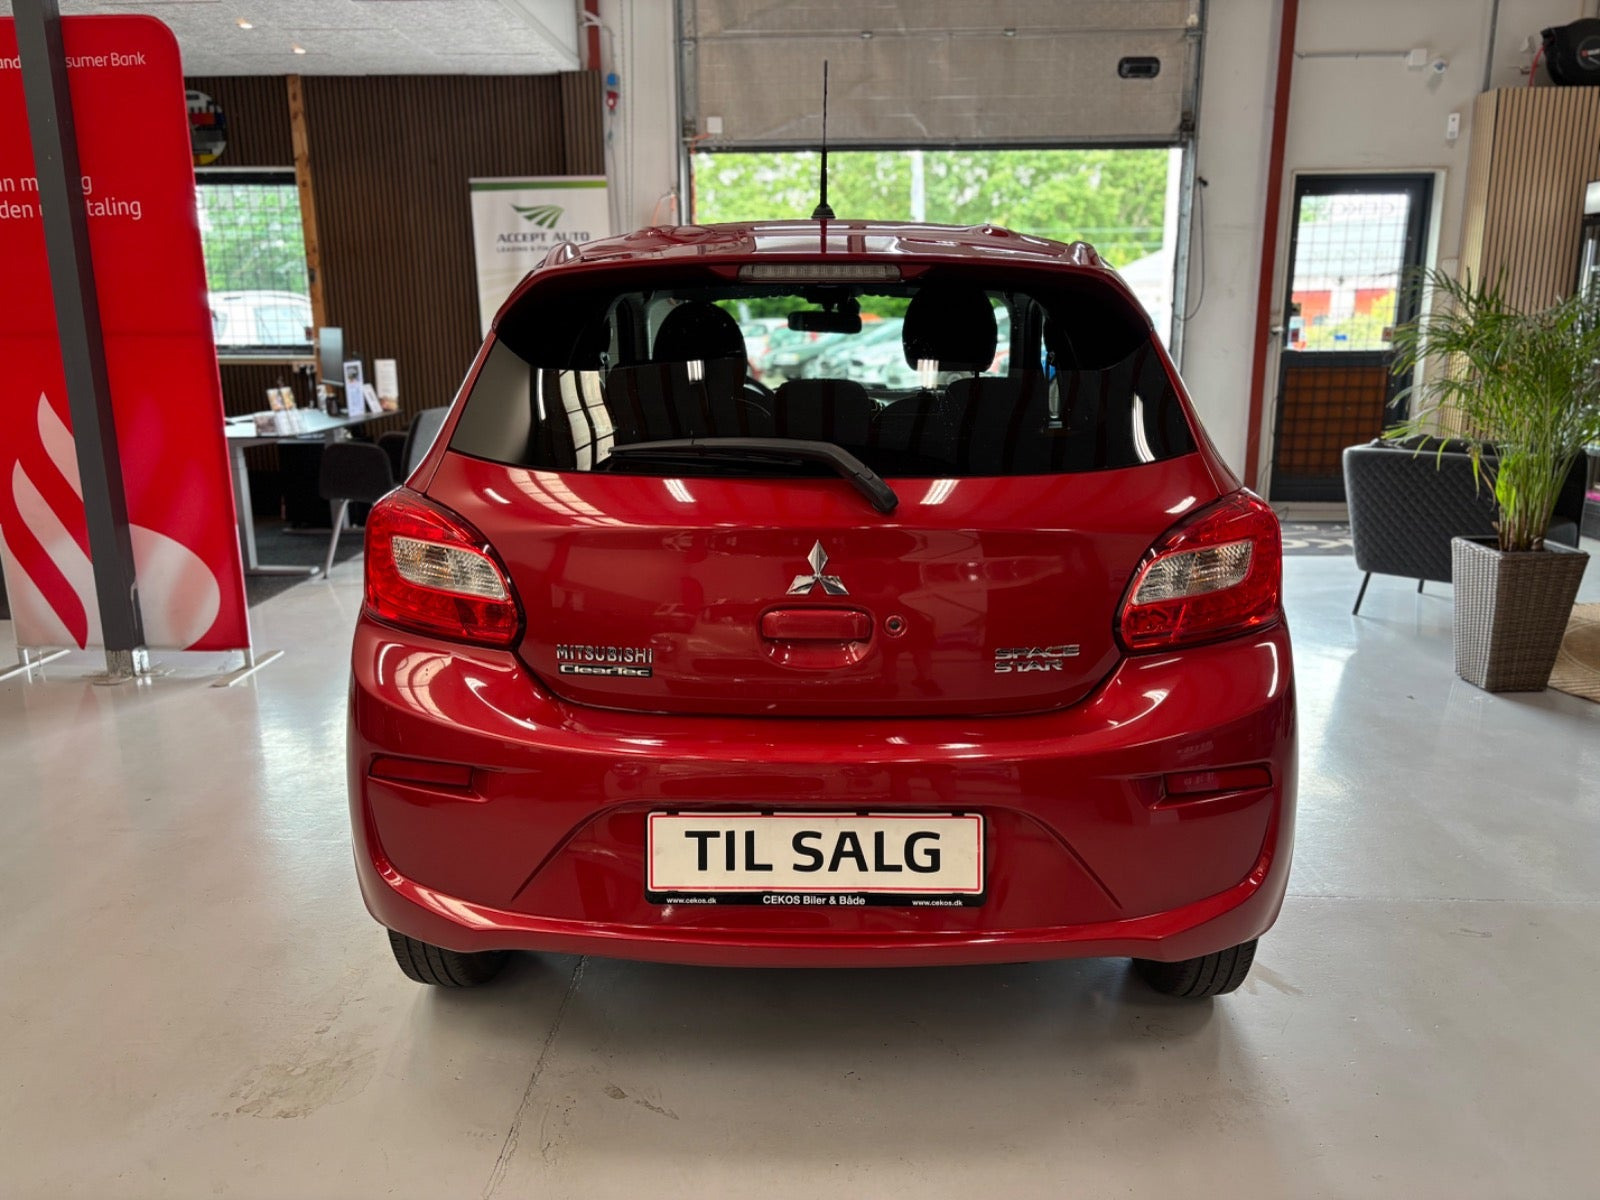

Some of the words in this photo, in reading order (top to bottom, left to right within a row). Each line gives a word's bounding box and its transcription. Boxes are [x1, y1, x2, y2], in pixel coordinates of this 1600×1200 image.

[65, 54, 108, 68] sumer
[110, 51, 147, 67] Bank
[496, 232, 547, 243] ACCEPT
[552, 231, 590, 242] AUTO
[556, 644, 653, 664] MITSUBISHI
[994, 644, 1081, 660] SPACE
[994, 659, 1063, 673] STAR
[684, 829, 773, 872] TIL
[791, 830, 942, 874] SALG
[666, 896, 717, 905] www.cekos.dk
[762, 894, 801, 905] CEKOS
[802, 895, 827, 905] Biler
[828, 895, 837, 905] &
[839, 894, 866, 905] Både
[912, 898, 964, 906] www.cekos.dk
